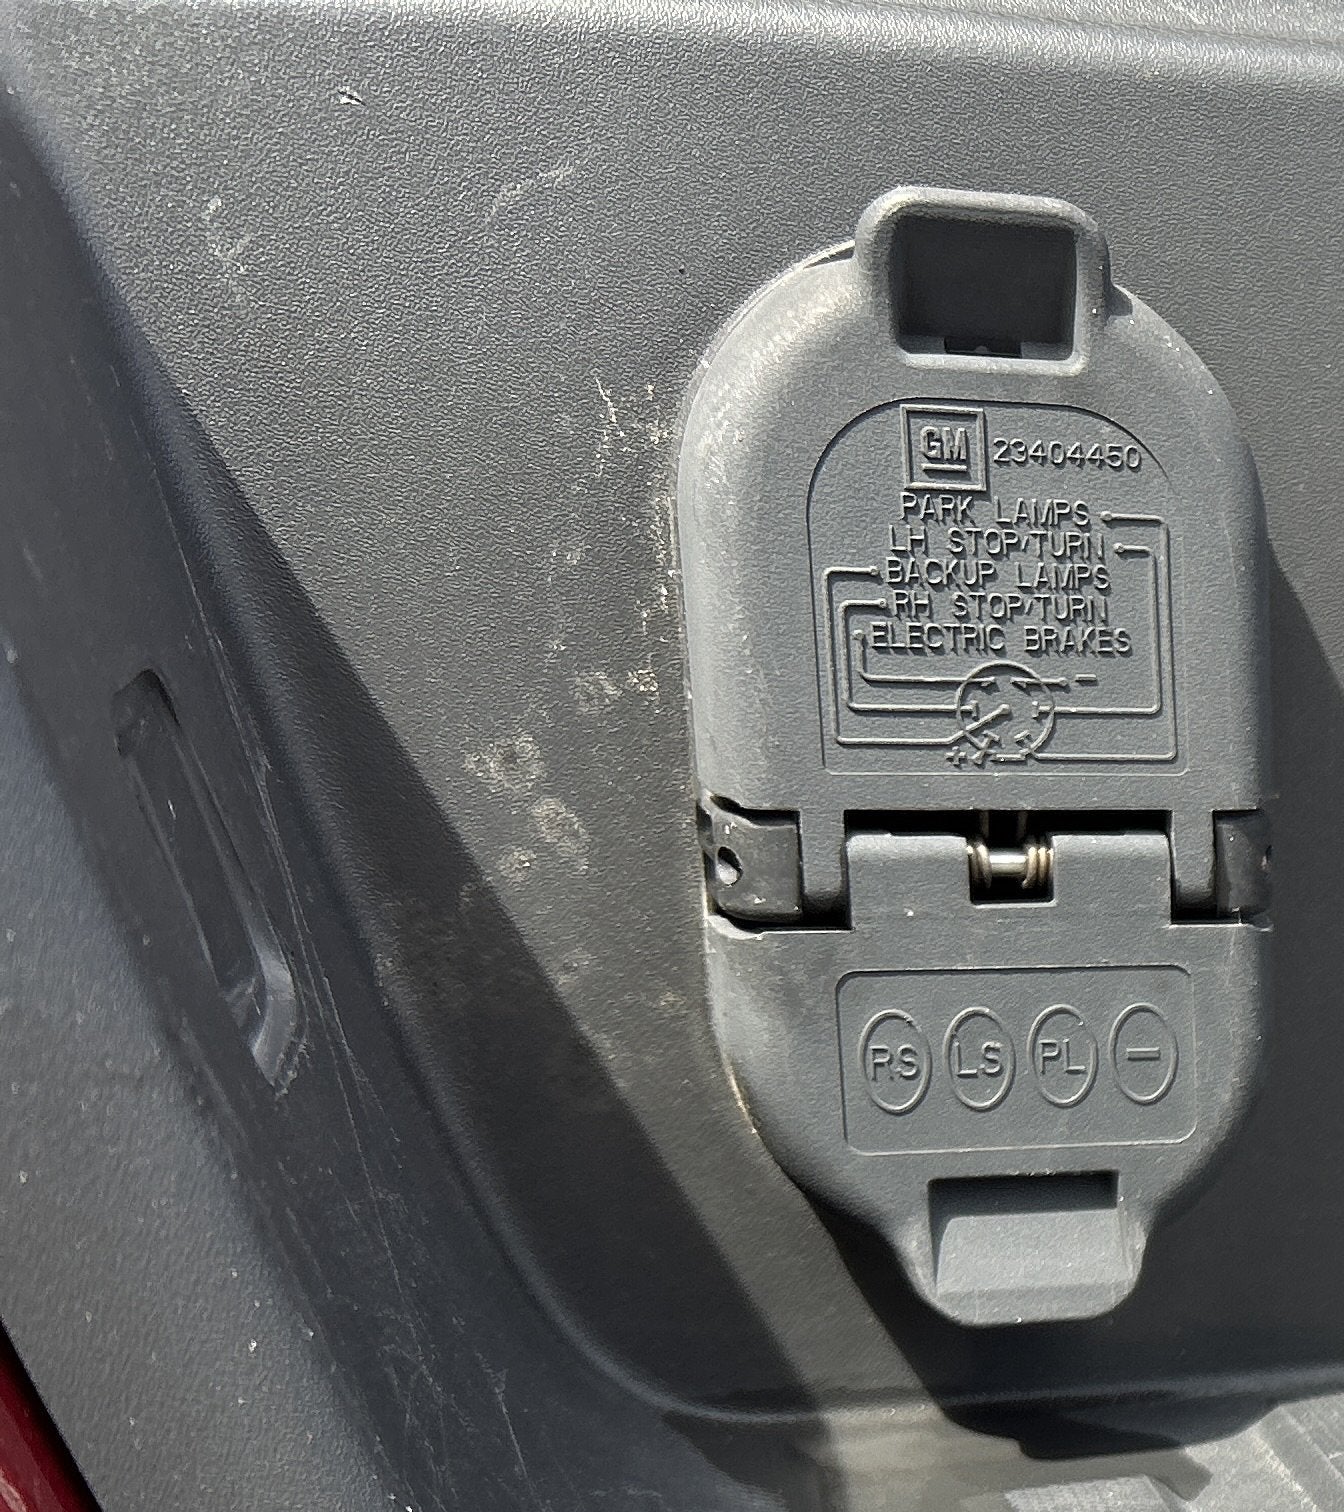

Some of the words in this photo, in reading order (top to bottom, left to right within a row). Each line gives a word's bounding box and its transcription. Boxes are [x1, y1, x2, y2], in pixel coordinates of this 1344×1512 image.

[919, 426, 969, 462] GM
[992, 438, 1142, 468] 23404450
[900, 492, 974, 522] PARK
[993, 496, 1091, 526] LAMPS
[889, 525, 927, 554] LH
[949, 528, 1106, 558] STOP/TURN
[885, 557, 996, 588] BACKUP
[1015, 562, 1111, 591] LAMPS
[893, 590, 931, 619] RH
[952, 592, 1107, 622] STOP/TURN
[871, 622, 1005, 651] ELECTRIC
[1024, 625, 1132, 653] BRAKES
[869, 1043, 919, 1081] RS
[954, 1040, 1001, 1078] LS
[1038, 1038, 1087, 1074] PL
